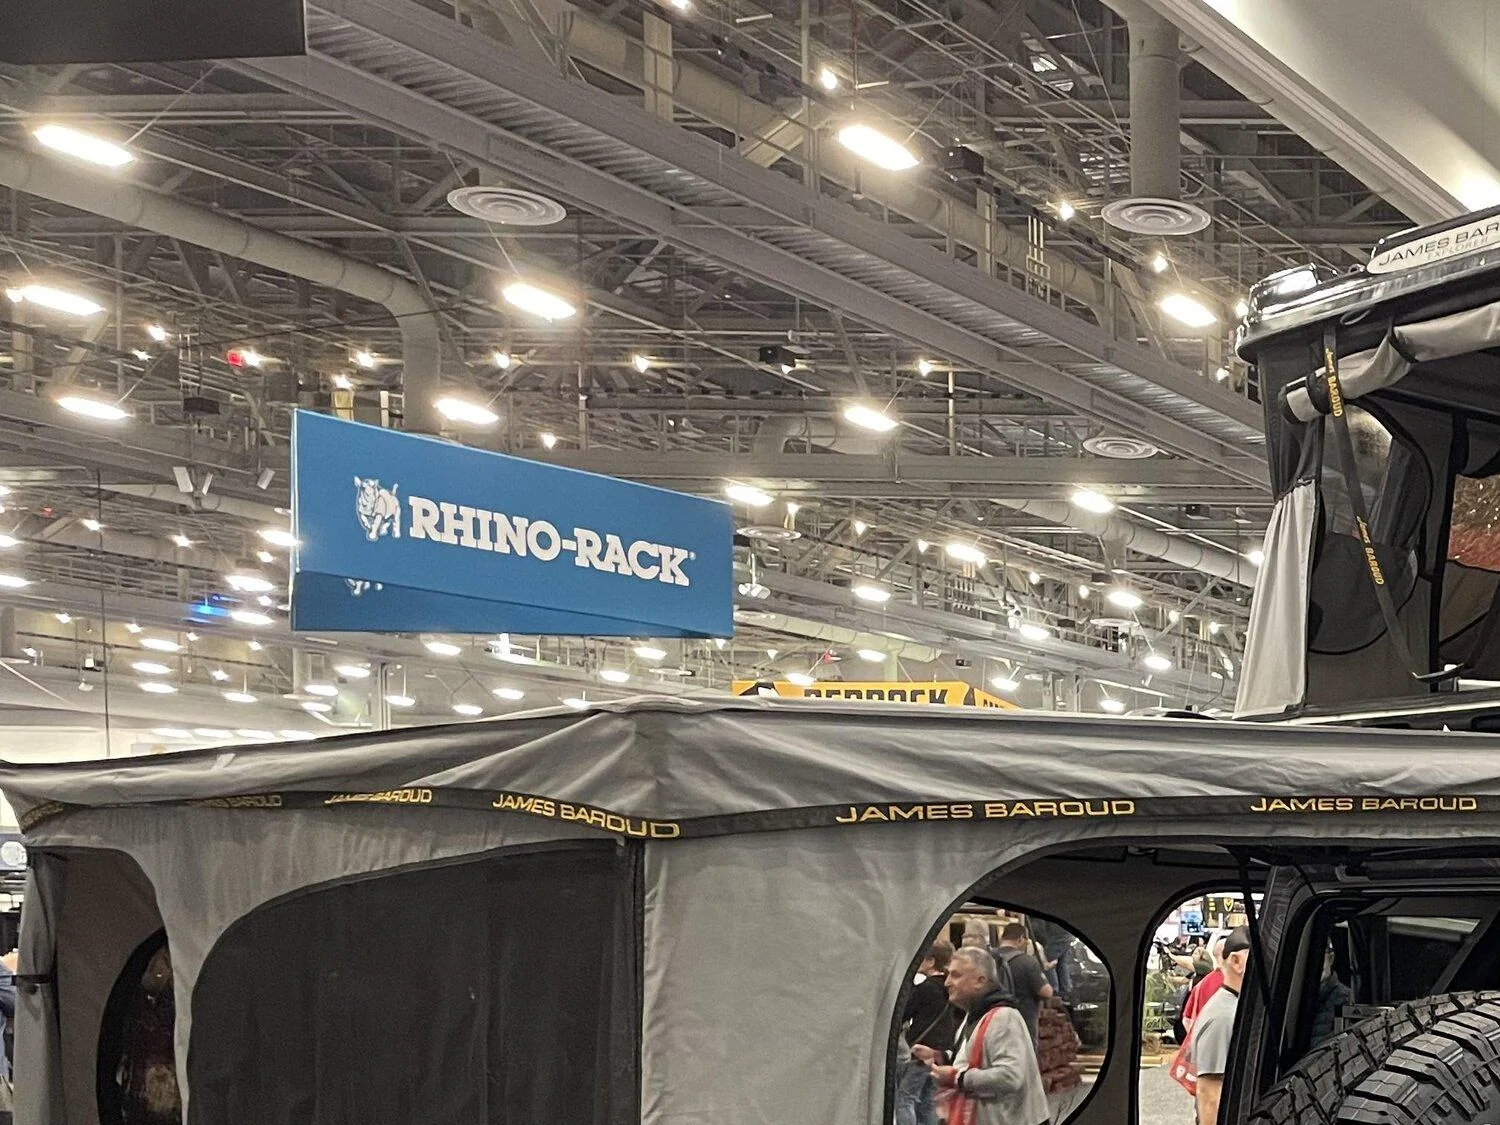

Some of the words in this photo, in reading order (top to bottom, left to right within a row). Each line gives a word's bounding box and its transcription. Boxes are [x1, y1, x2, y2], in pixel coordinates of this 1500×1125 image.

[1378, 236, 1450, 267] JAMES
[1328, 375, 1343, 417] BAROUD
[408, 495, 691, 587] RHINO-RACK
[1365, 547, 1385, 585] BAROUD
[492, 793, 556, 818] JAMES
[560, 804, 681, 839] BAROUD
[835, 804, 974, 823] JAMES
[984, 800, 1135, 819] BAROUD
[1250, 797, 1354, 812] JAMES
[1361, 797, 1478, 812] BAROUD
